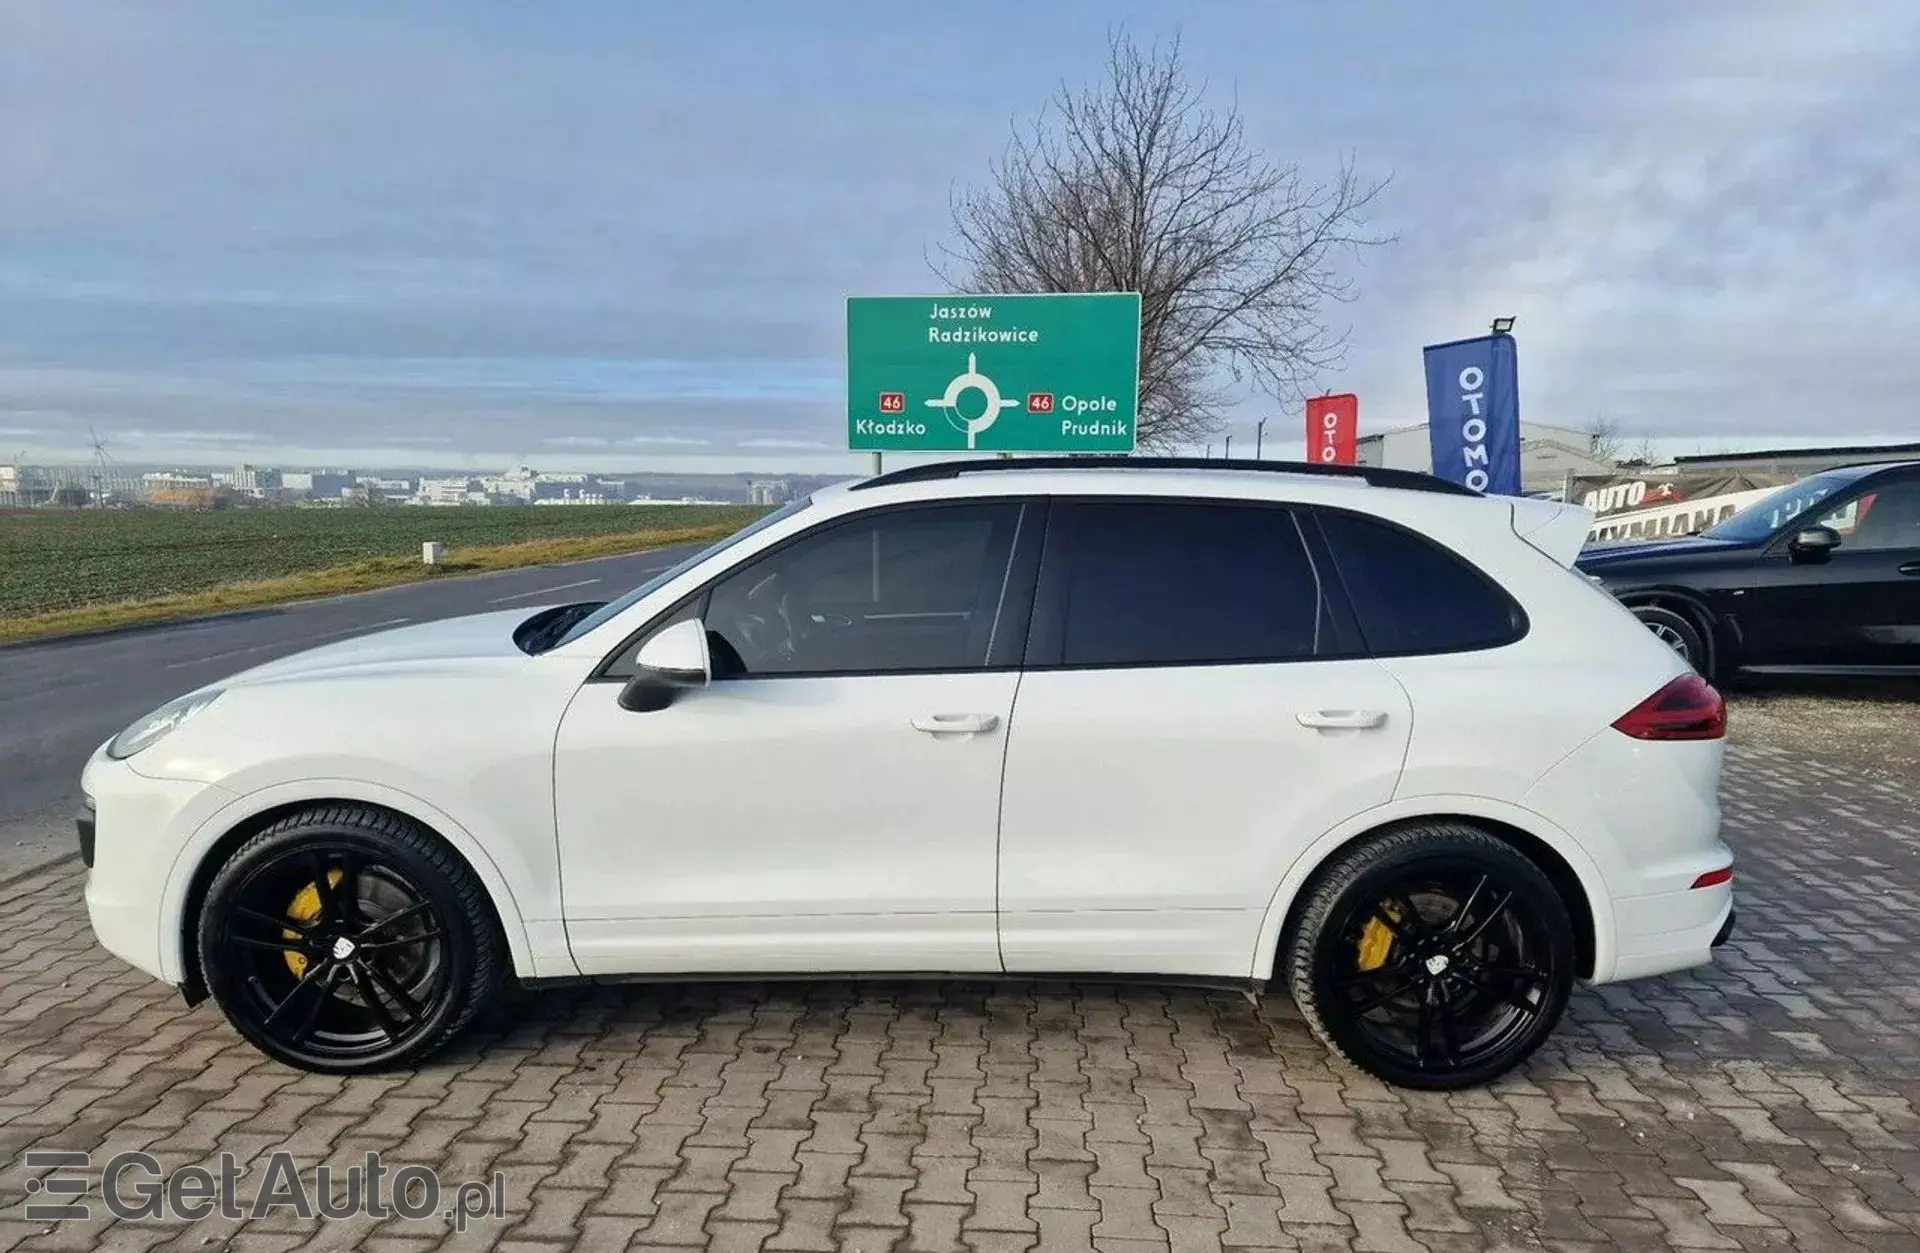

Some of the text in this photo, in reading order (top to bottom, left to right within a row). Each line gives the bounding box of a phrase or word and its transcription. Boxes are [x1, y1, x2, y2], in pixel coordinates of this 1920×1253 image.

[929, 303, 992, 319] Jaszów
[929, 326, 1039, 343] Radzikowice
[883, 396, 901, 410] 46
[1031, 395, 1117, 415] 46 Opole
[856, 418, 926, 436] Kłodzko
[1062, 419, 1128, 436] Prudnik
[1583, 481, 1647, 514] AUTO
